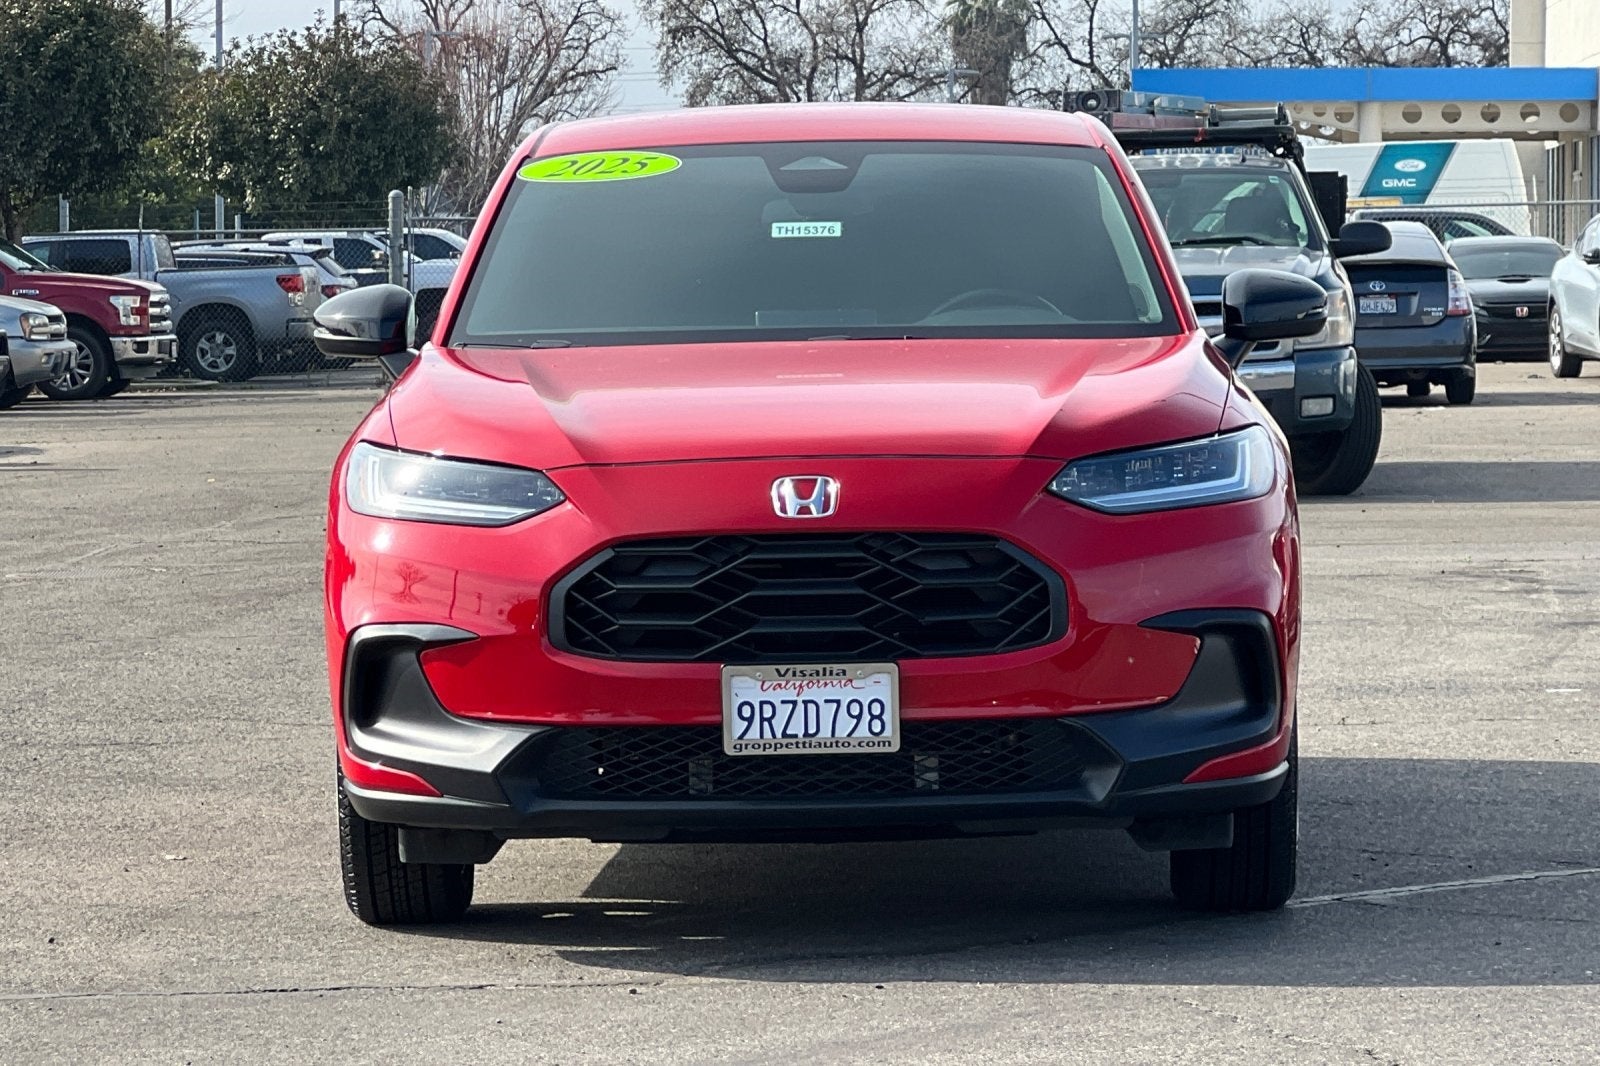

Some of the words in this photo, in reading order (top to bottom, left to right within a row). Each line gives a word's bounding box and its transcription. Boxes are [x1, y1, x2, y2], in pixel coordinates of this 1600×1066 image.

[543, 157, 660, 177] 2025
[1382, 179, 1416, 187] GMC
[776, 226, 835, 235] TH15376
[775, 667, 847, 678] Visalia
[760, 678, 865, 697] California
[737, 697, 886, 740] 9RZD798
[733, 739, 892, 753] groppettiauto.com
